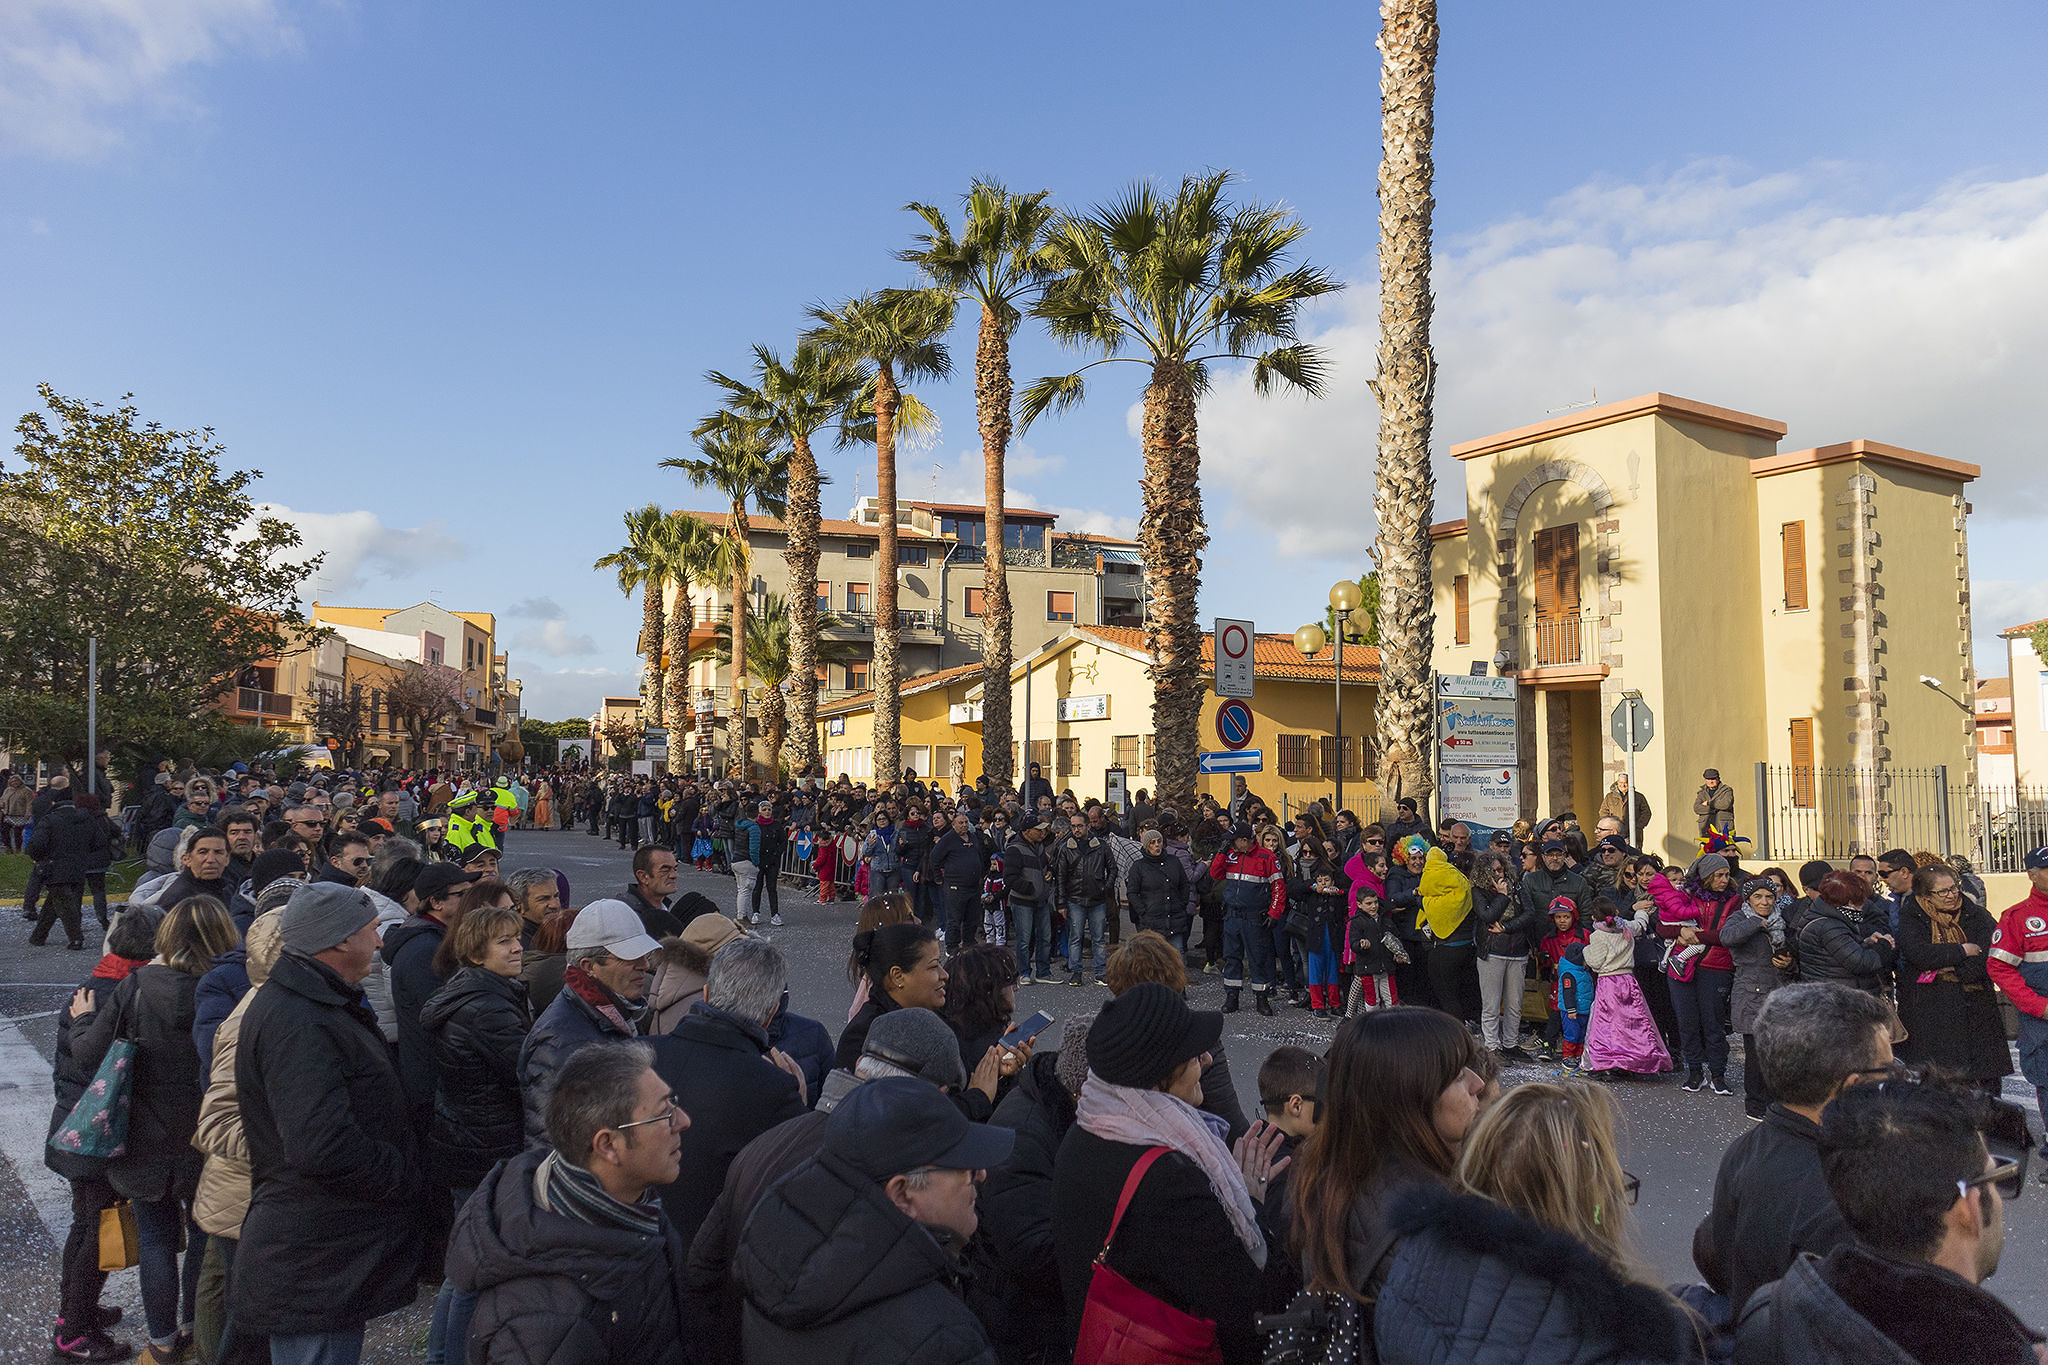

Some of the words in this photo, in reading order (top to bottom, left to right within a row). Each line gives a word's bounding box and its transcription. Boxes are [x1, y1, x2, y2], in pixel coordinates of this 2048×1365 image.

[1445, 773, 1461, 784] Centro
[1462, 773, 1491, 785] Fisioterapico
[1480, 786, 1495, 796] Forma
[1496, 786, 1512, 796] mentis
